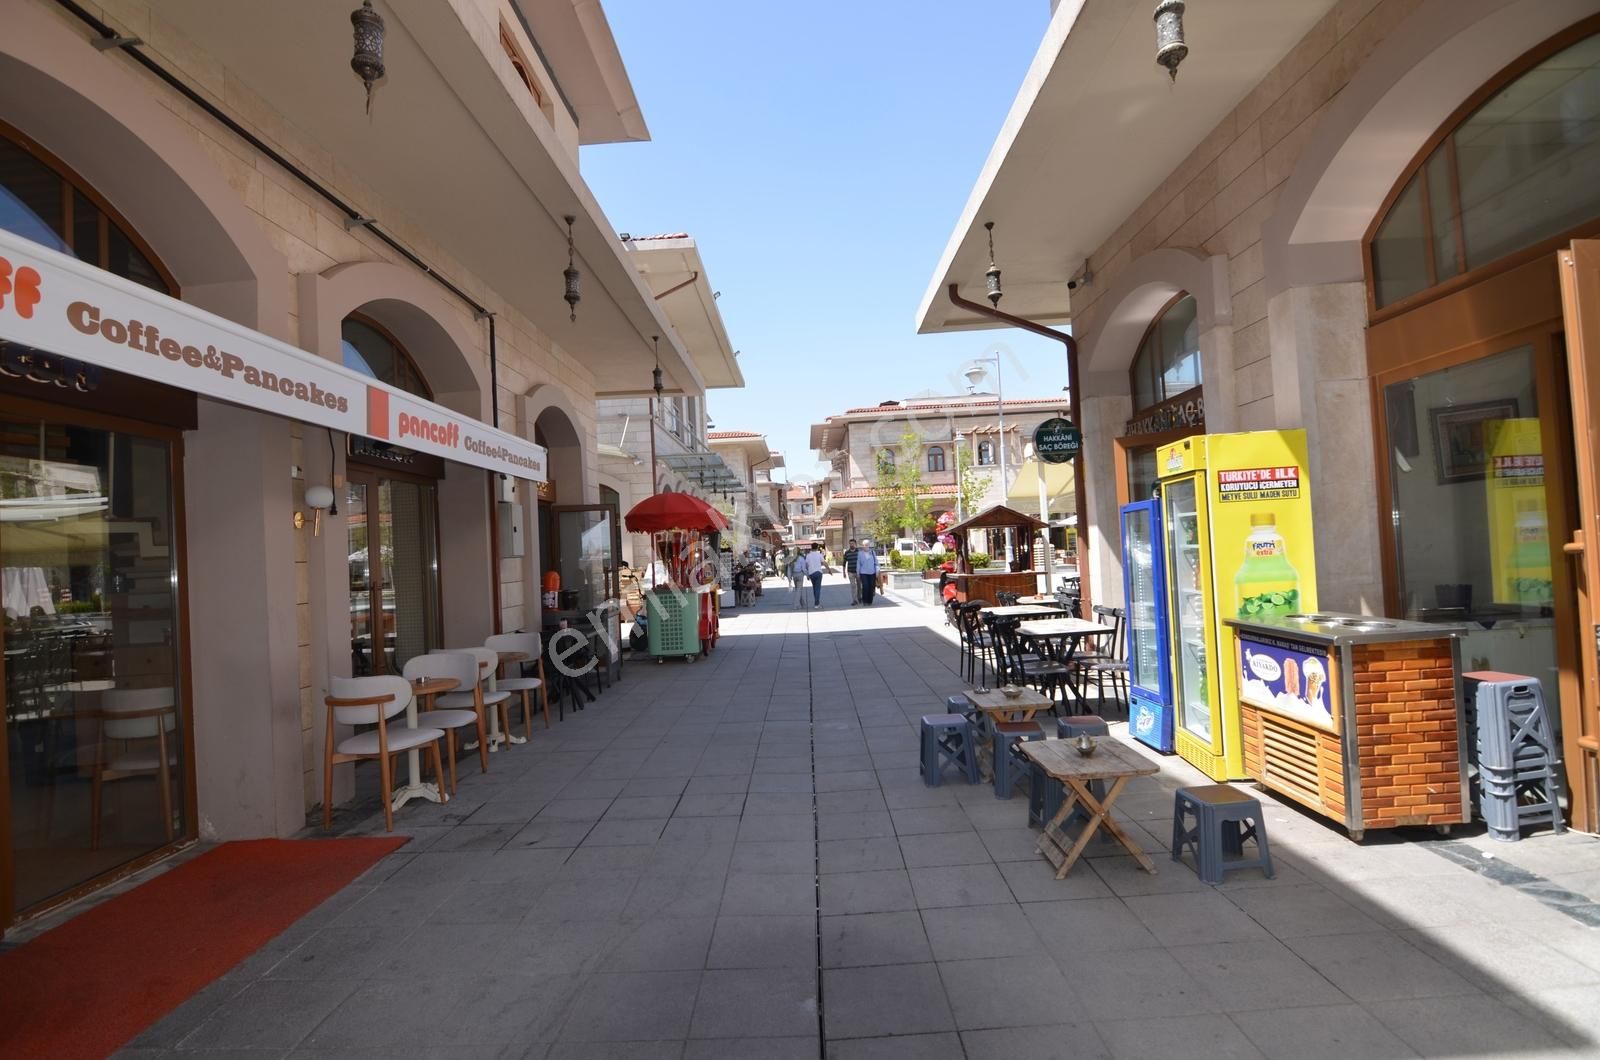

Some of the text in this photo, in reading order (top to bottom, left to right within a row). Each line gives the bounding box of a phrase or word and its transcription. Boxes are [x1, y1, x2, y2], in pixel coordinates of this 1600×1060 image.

[66, 301, 349, 413] Coffee&Pancakes
[398, 411, 541, 472] pancoff Coffee&Pancakes
[1038, 443, 1053, 452] SAÇ
[1222, 492, 1241, 500] MEYVE
[1243, 491, 1258, 500] SULU
[1260, 490, 1280, 498] MADEN
